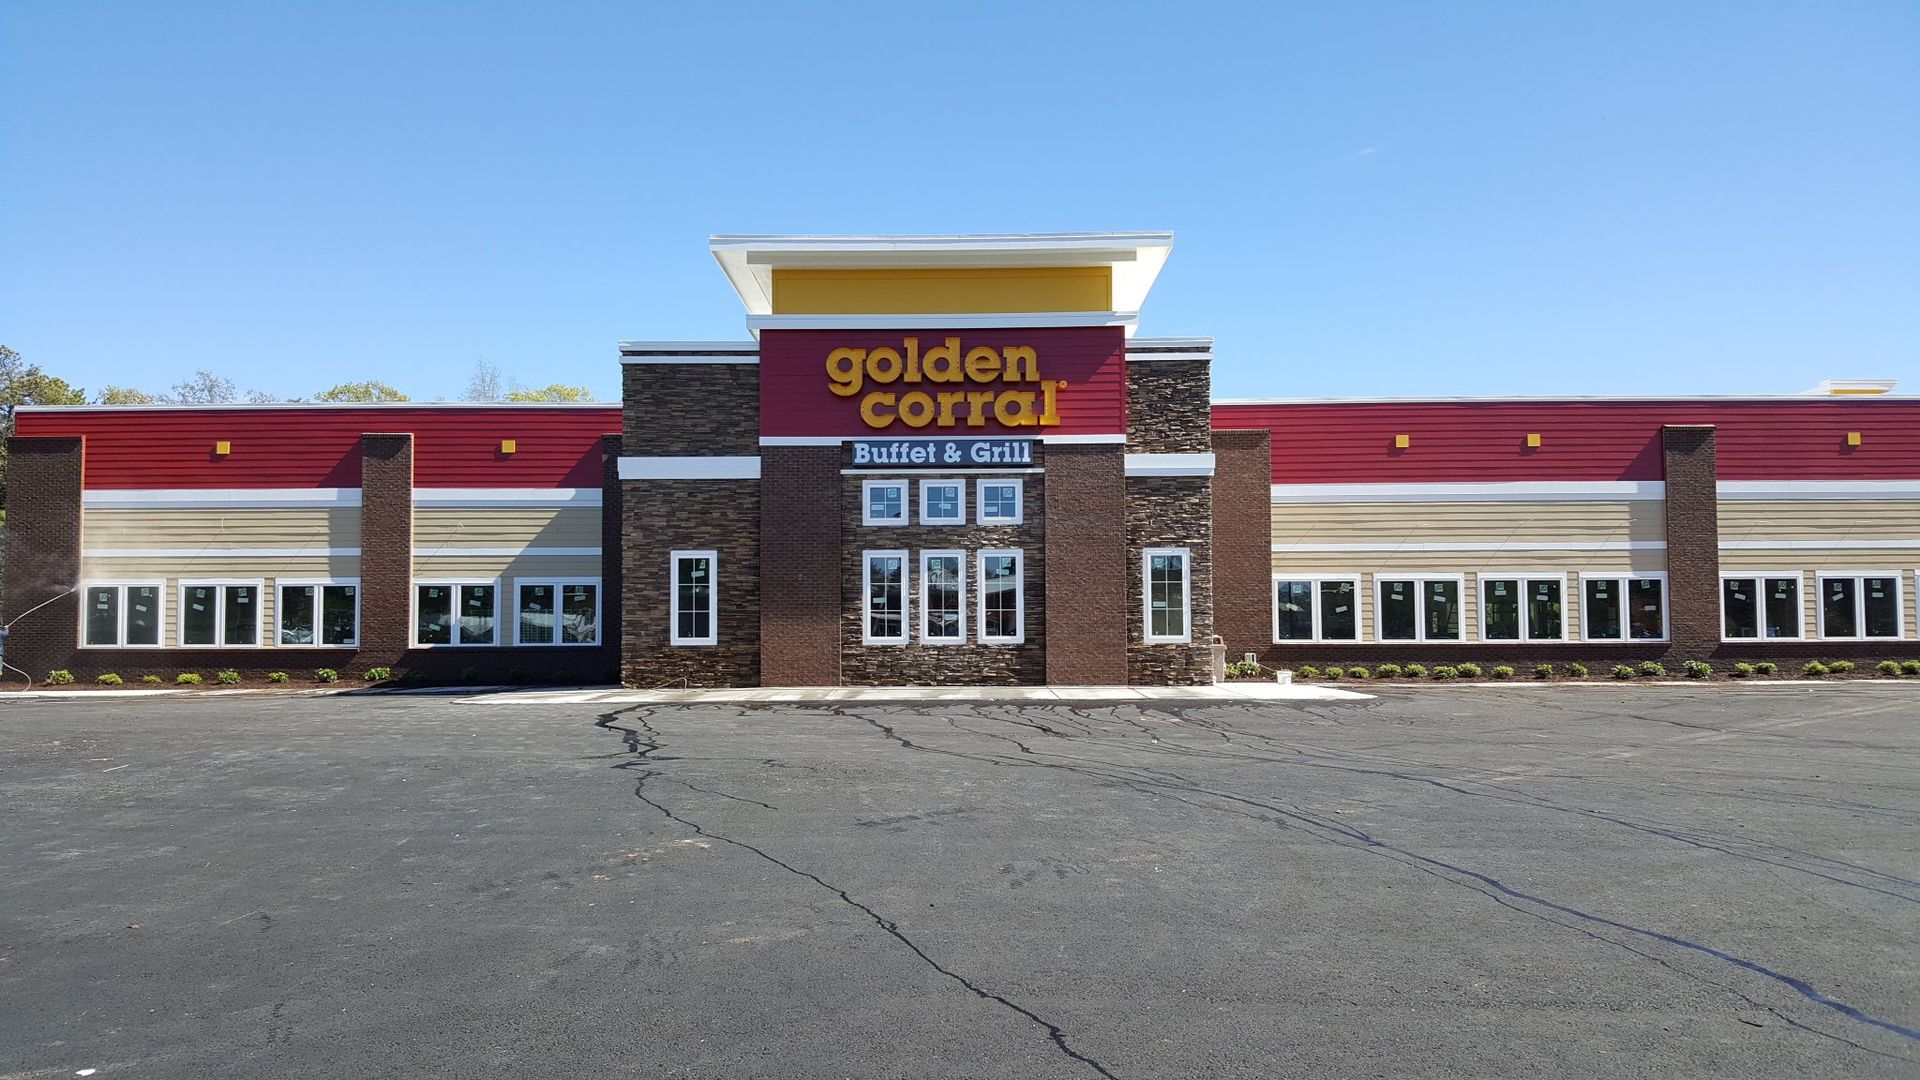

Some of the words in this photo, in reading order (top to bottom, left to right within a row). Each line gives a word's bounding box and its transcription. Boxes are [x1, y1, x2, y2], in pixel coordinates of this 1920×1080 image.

[825, 336, 1040, 397] golden
[859, 379, 1061, 428] corral
[854, 443, 936, 463] Buffet
[943, 443, 961, 463] &
[970, 442, 1032, 463] Grill
